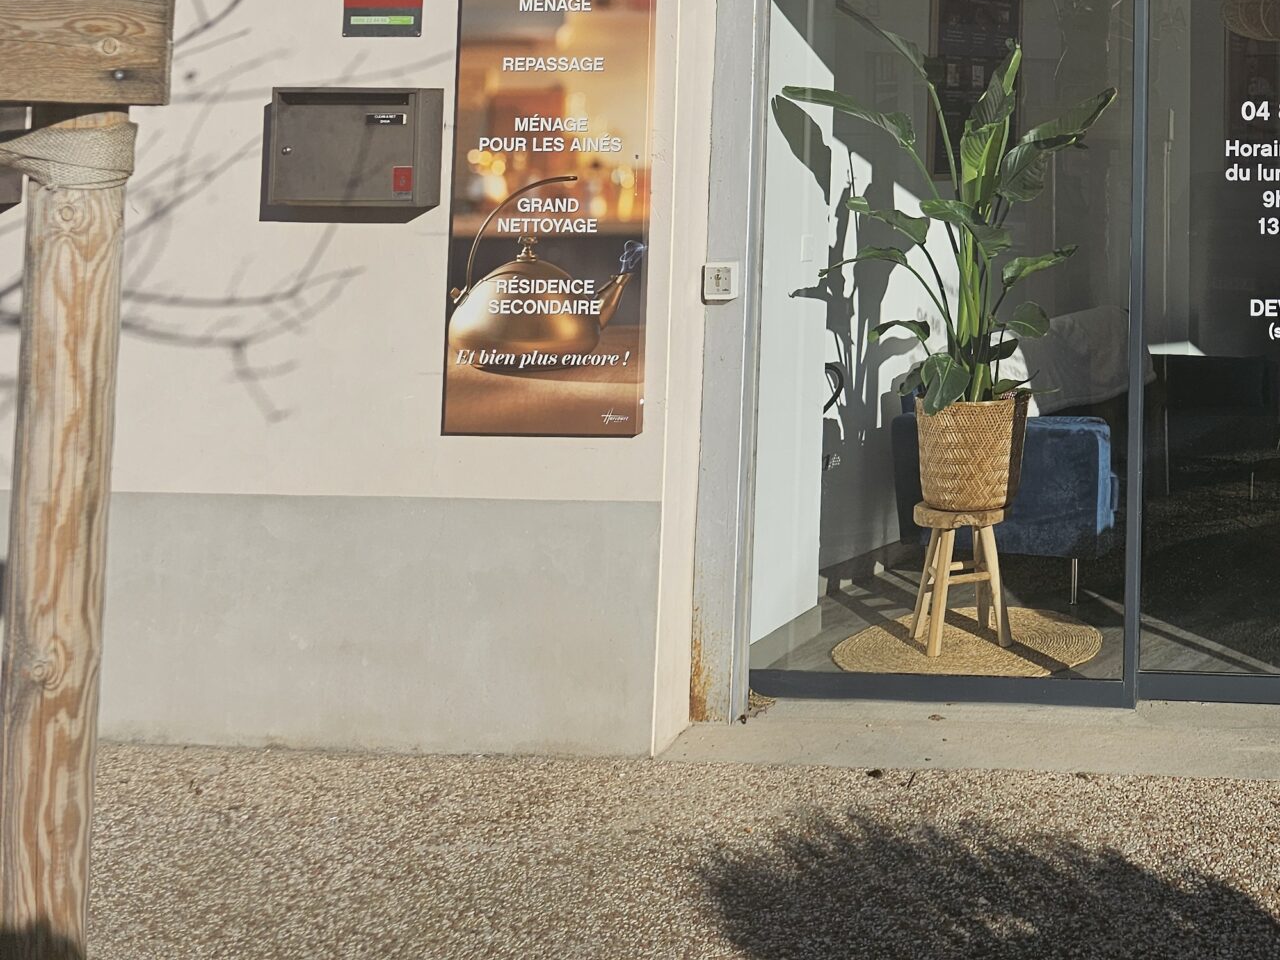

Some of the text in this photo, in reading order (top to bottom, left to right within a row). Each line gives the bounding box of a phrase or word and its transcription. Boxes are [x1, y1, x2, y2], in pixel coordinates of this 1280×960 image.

[502, 57, 604, 72] REPASSAGE
[1241, 101, 1270, 121] 04
[514, 114, 588, 132] MÉNAGE
[479, 133, 622, 152] POUR LES AINÉS
[1225, 163, 1250, 181] du
[517, 198, 579, 213] GRAND
[497, 218, 597, 233] NETTOYAGE
[496, 276, 595, 294] RÉSIDENCE
[488, 299, 601, 315] SECONDAIRE
[456, 349, 630, 368] Et bien plus encore !
